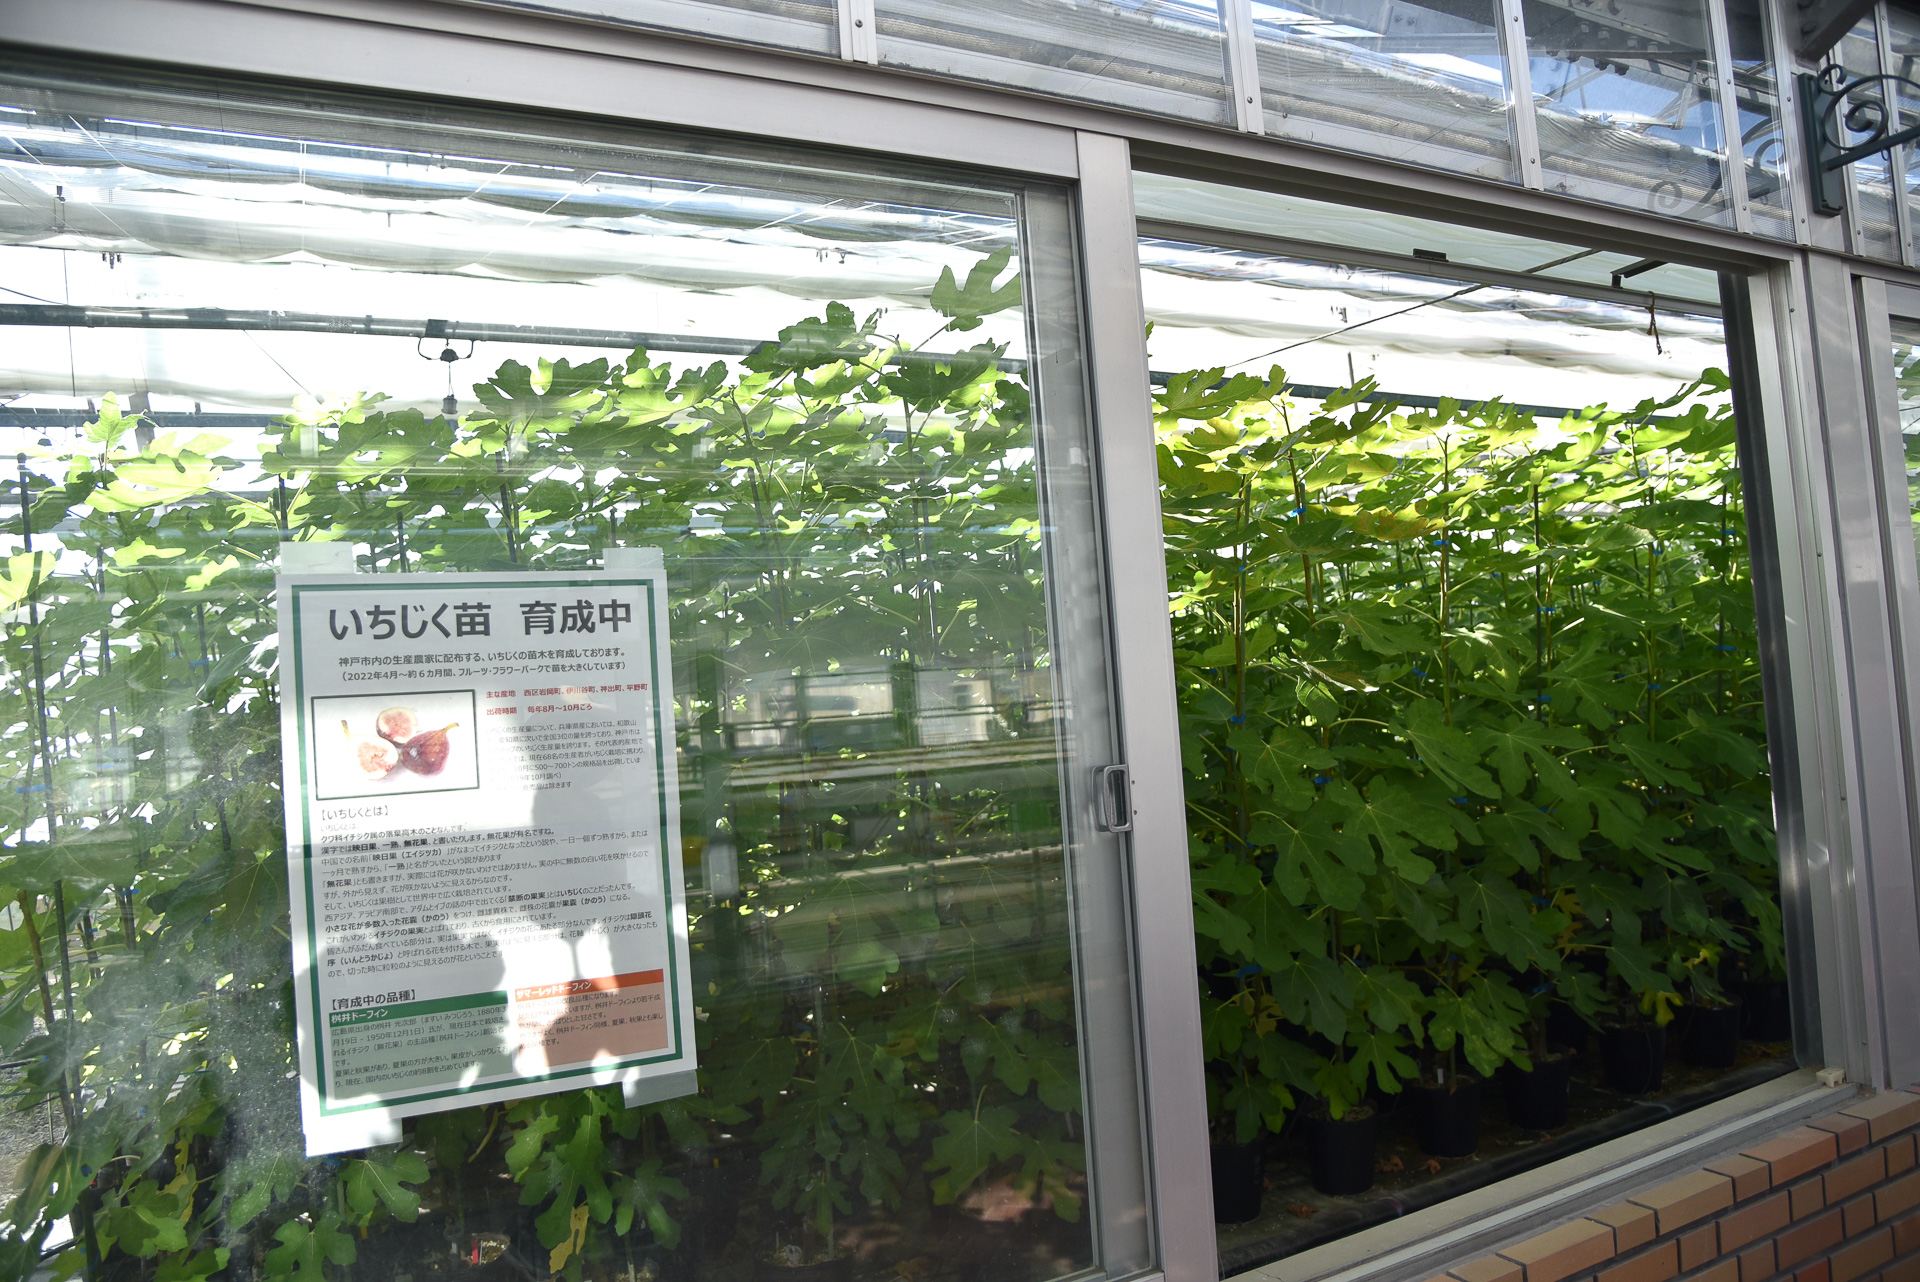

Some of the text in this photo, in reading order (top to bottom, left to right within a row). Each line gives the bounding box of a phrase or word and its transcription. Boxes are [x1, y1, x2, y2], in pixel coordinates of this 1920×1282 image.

[326, 596, 634, 643] いちじく苗 育成中
[484, 688, 517, 699] 主な産地
[484, 705, 518, 717] 出荷時期
[330, 987, 419, 1013] 【育成中の品種】
[331, 1035, 358, 1047] 月19日
[333, 1056, 353, 1069] です。
